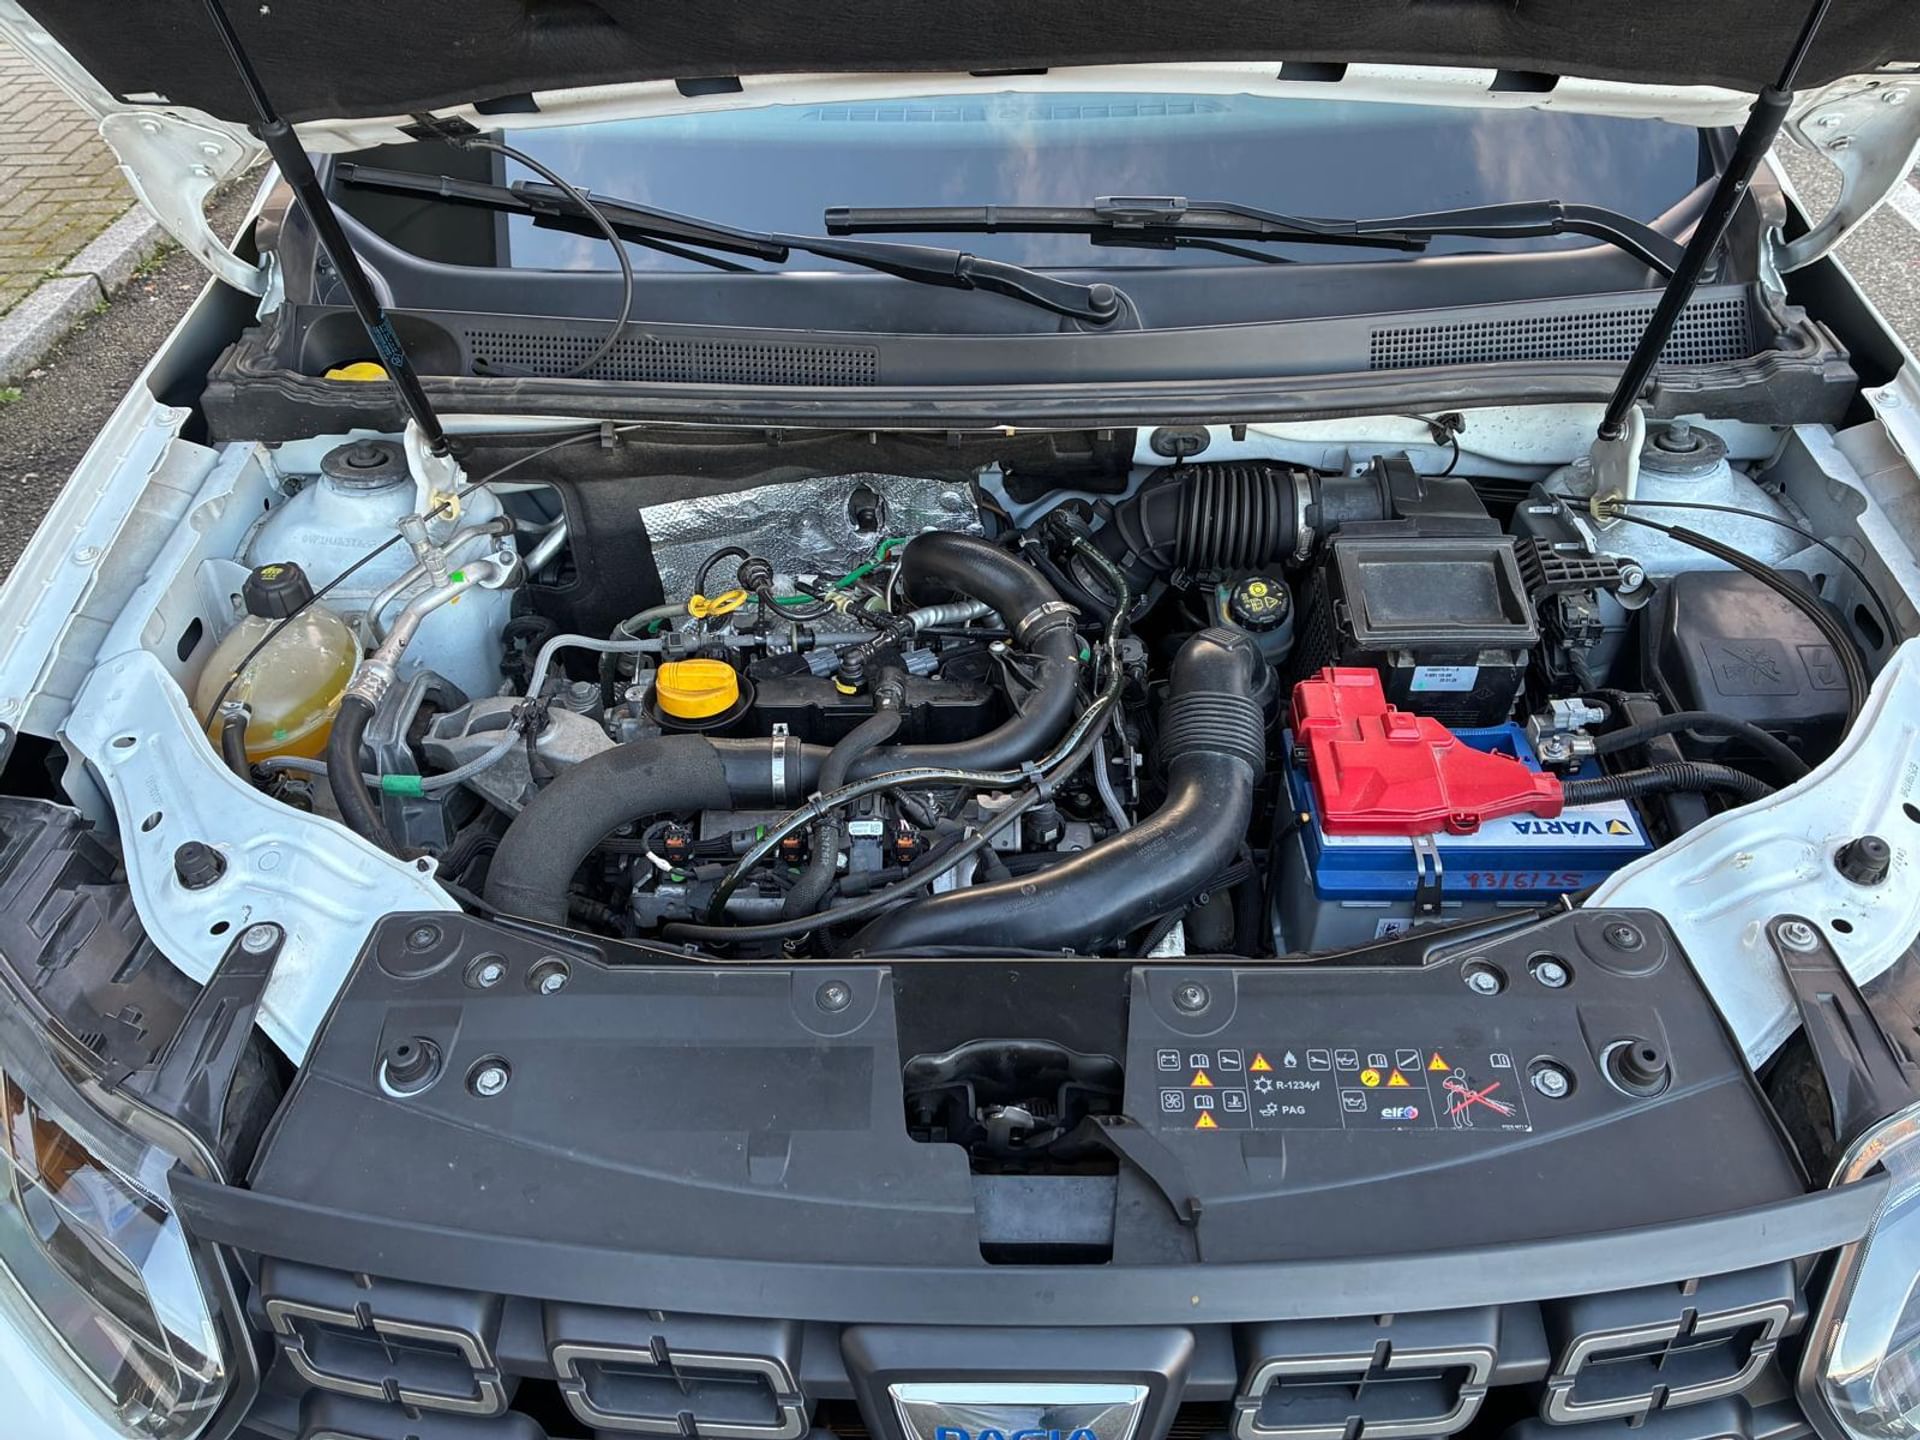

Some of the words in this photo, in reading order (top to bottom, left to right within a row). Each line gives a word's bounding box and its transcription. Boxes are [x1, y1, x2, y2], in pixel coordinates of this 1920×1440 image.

[1511, 820, 1603, 835] VARTA
[1276, 1080, 1320, 1091] R-1234yf
[1282, 1105, 1306, 1115] PAG
